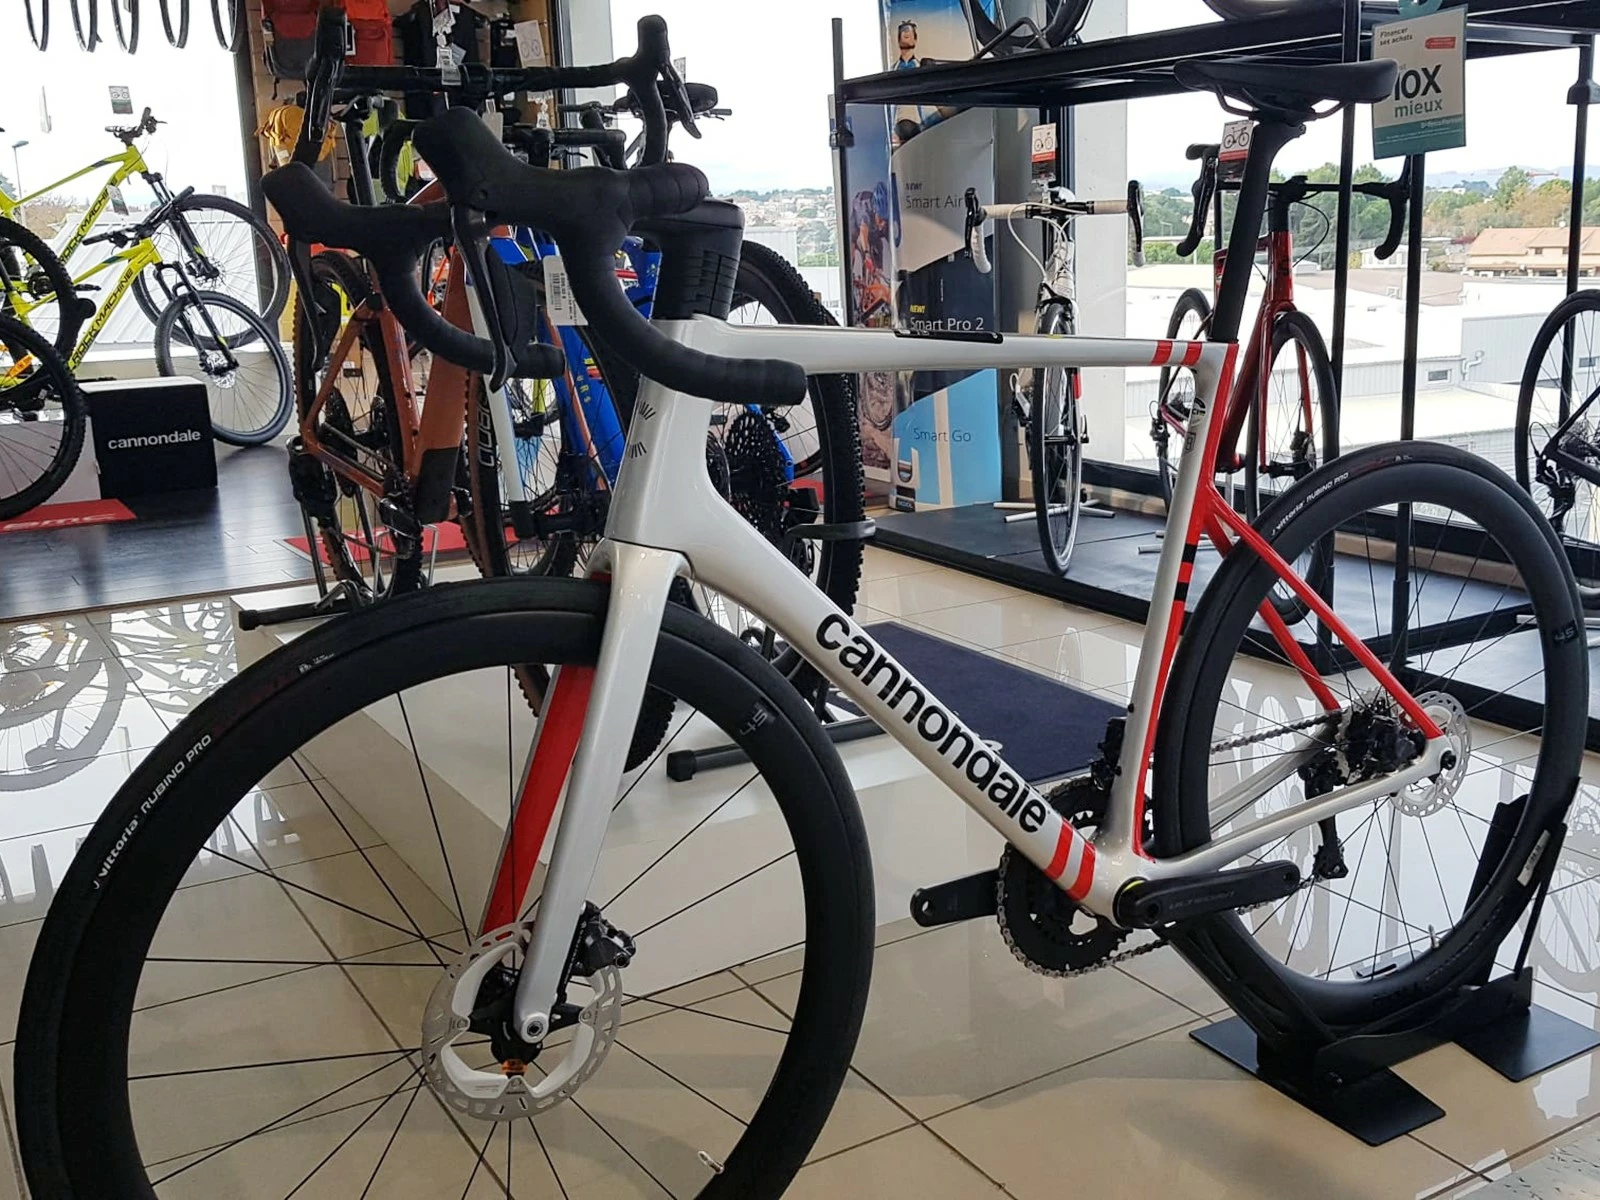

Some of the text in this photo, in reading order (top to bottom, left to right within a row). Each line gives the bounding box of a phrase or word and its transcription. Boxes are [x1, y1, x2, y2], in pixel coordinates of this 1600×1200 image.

[1380, 28, 1409, 38] Financer
[1394, 99, 1442, 118] mieux
[906, 195, 964, 209] Smart Air
[71, 267, 134, 364] ROCK MACHINE
[910, 317, 984, 332] Smart Pro 2
[108, 429, 201, 449] cannondale
[913, 427, 972, 442] Smart Go
[740, 708, 768, 736] 45
[816, 613, 1047, 834] cannondale
[140, 760, 186, 814] RUBINO
[185, 734, 212, 763] PRO
